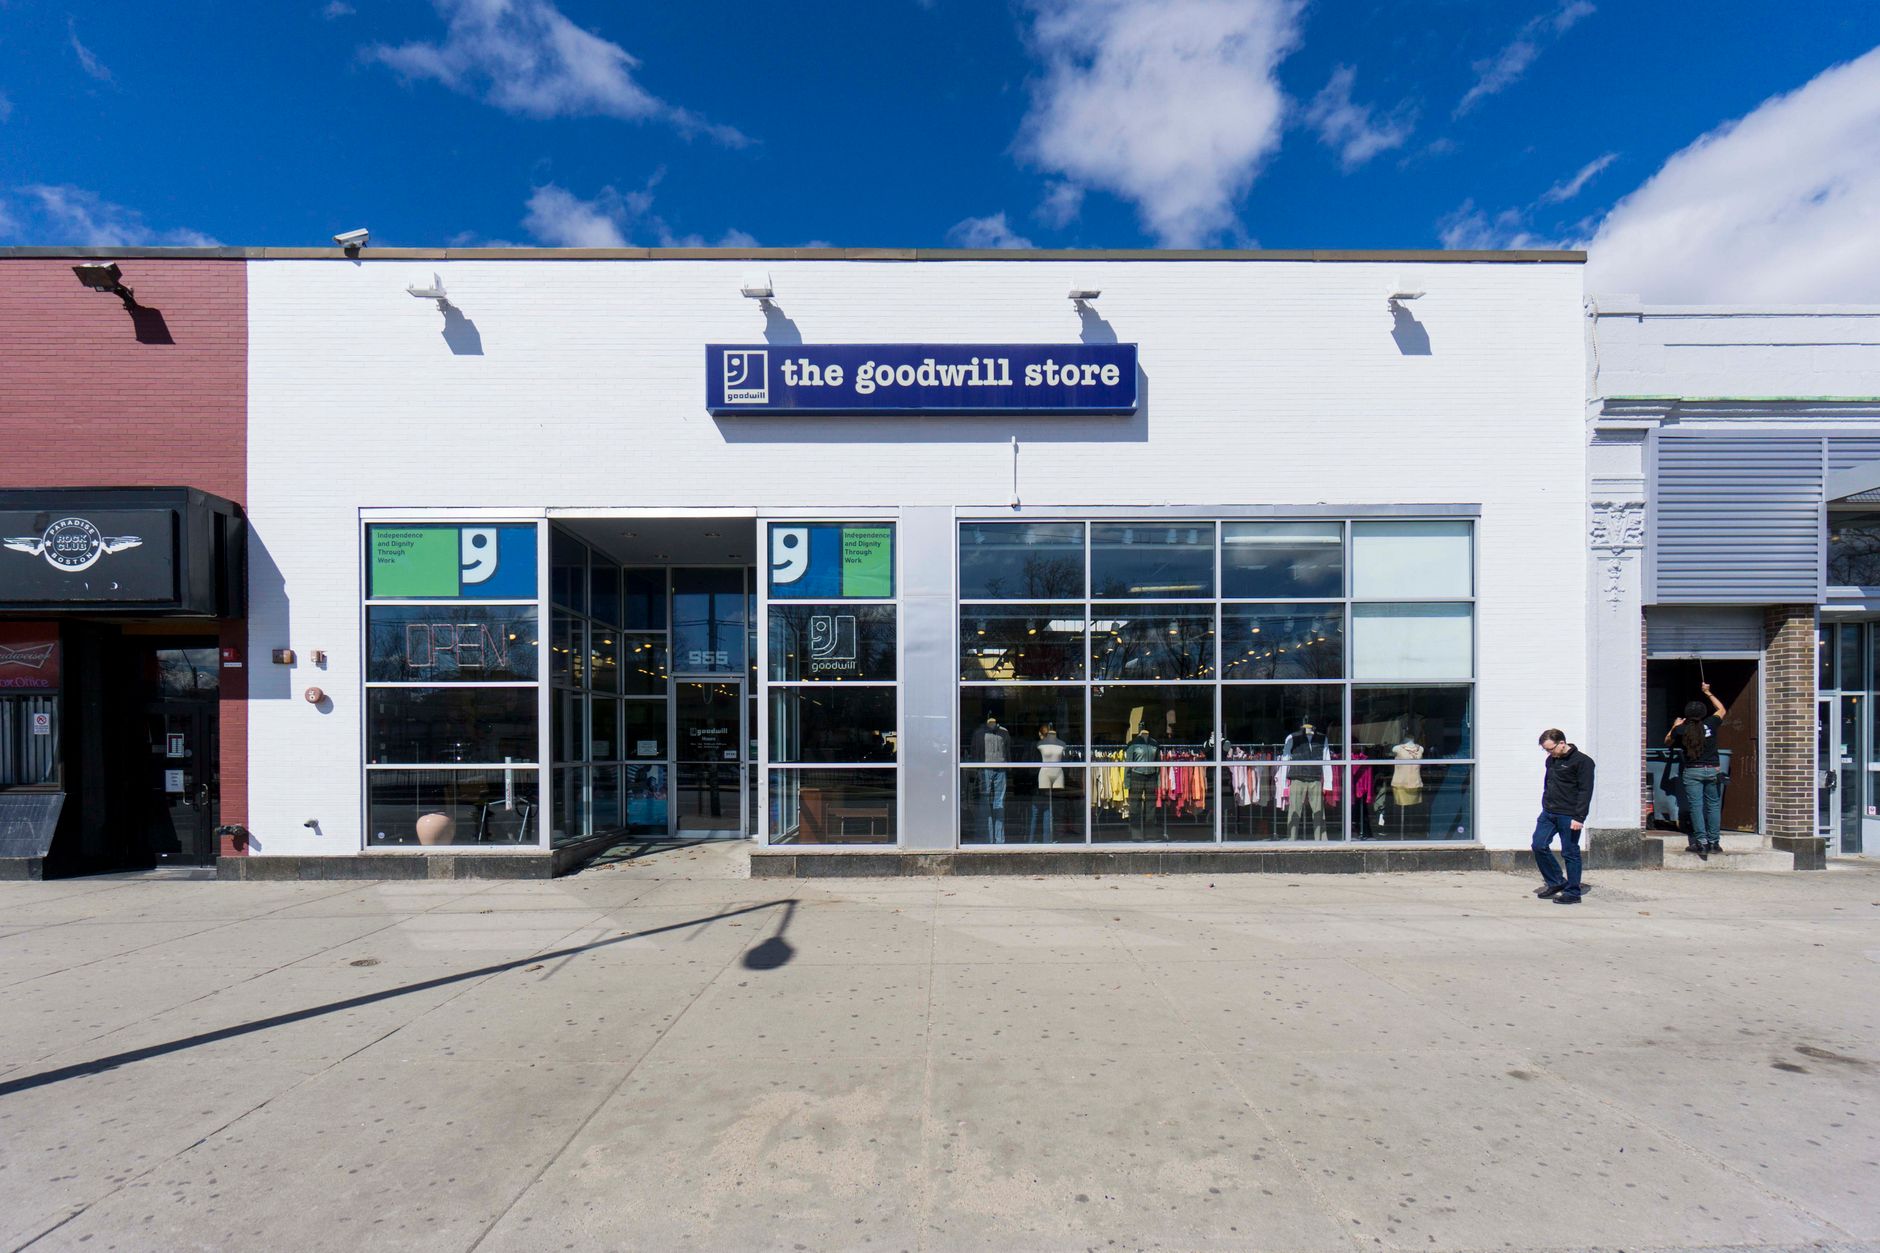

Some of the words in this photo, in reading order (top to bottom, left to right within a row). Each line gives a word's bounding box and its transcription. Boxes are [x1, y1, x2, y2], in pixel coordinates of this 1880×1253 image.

[780, 358, 844, 387] the
[855, 357, 1013, 395] goodwill
[1024, 358, 1120, 387] store
[727, 391, 766, 402] goodwill
[49, 519, 95, 535] PARADISE
[57, 534, 88, 543] ROCK
[57, 542, 87, 551] CLUB
[51, 552, 93, 565] BOSTON
[406, 623, 506, 667] OPEN
[811, 661, 856, 673] goodwill
[697, 727, 728, 736] goodwill
